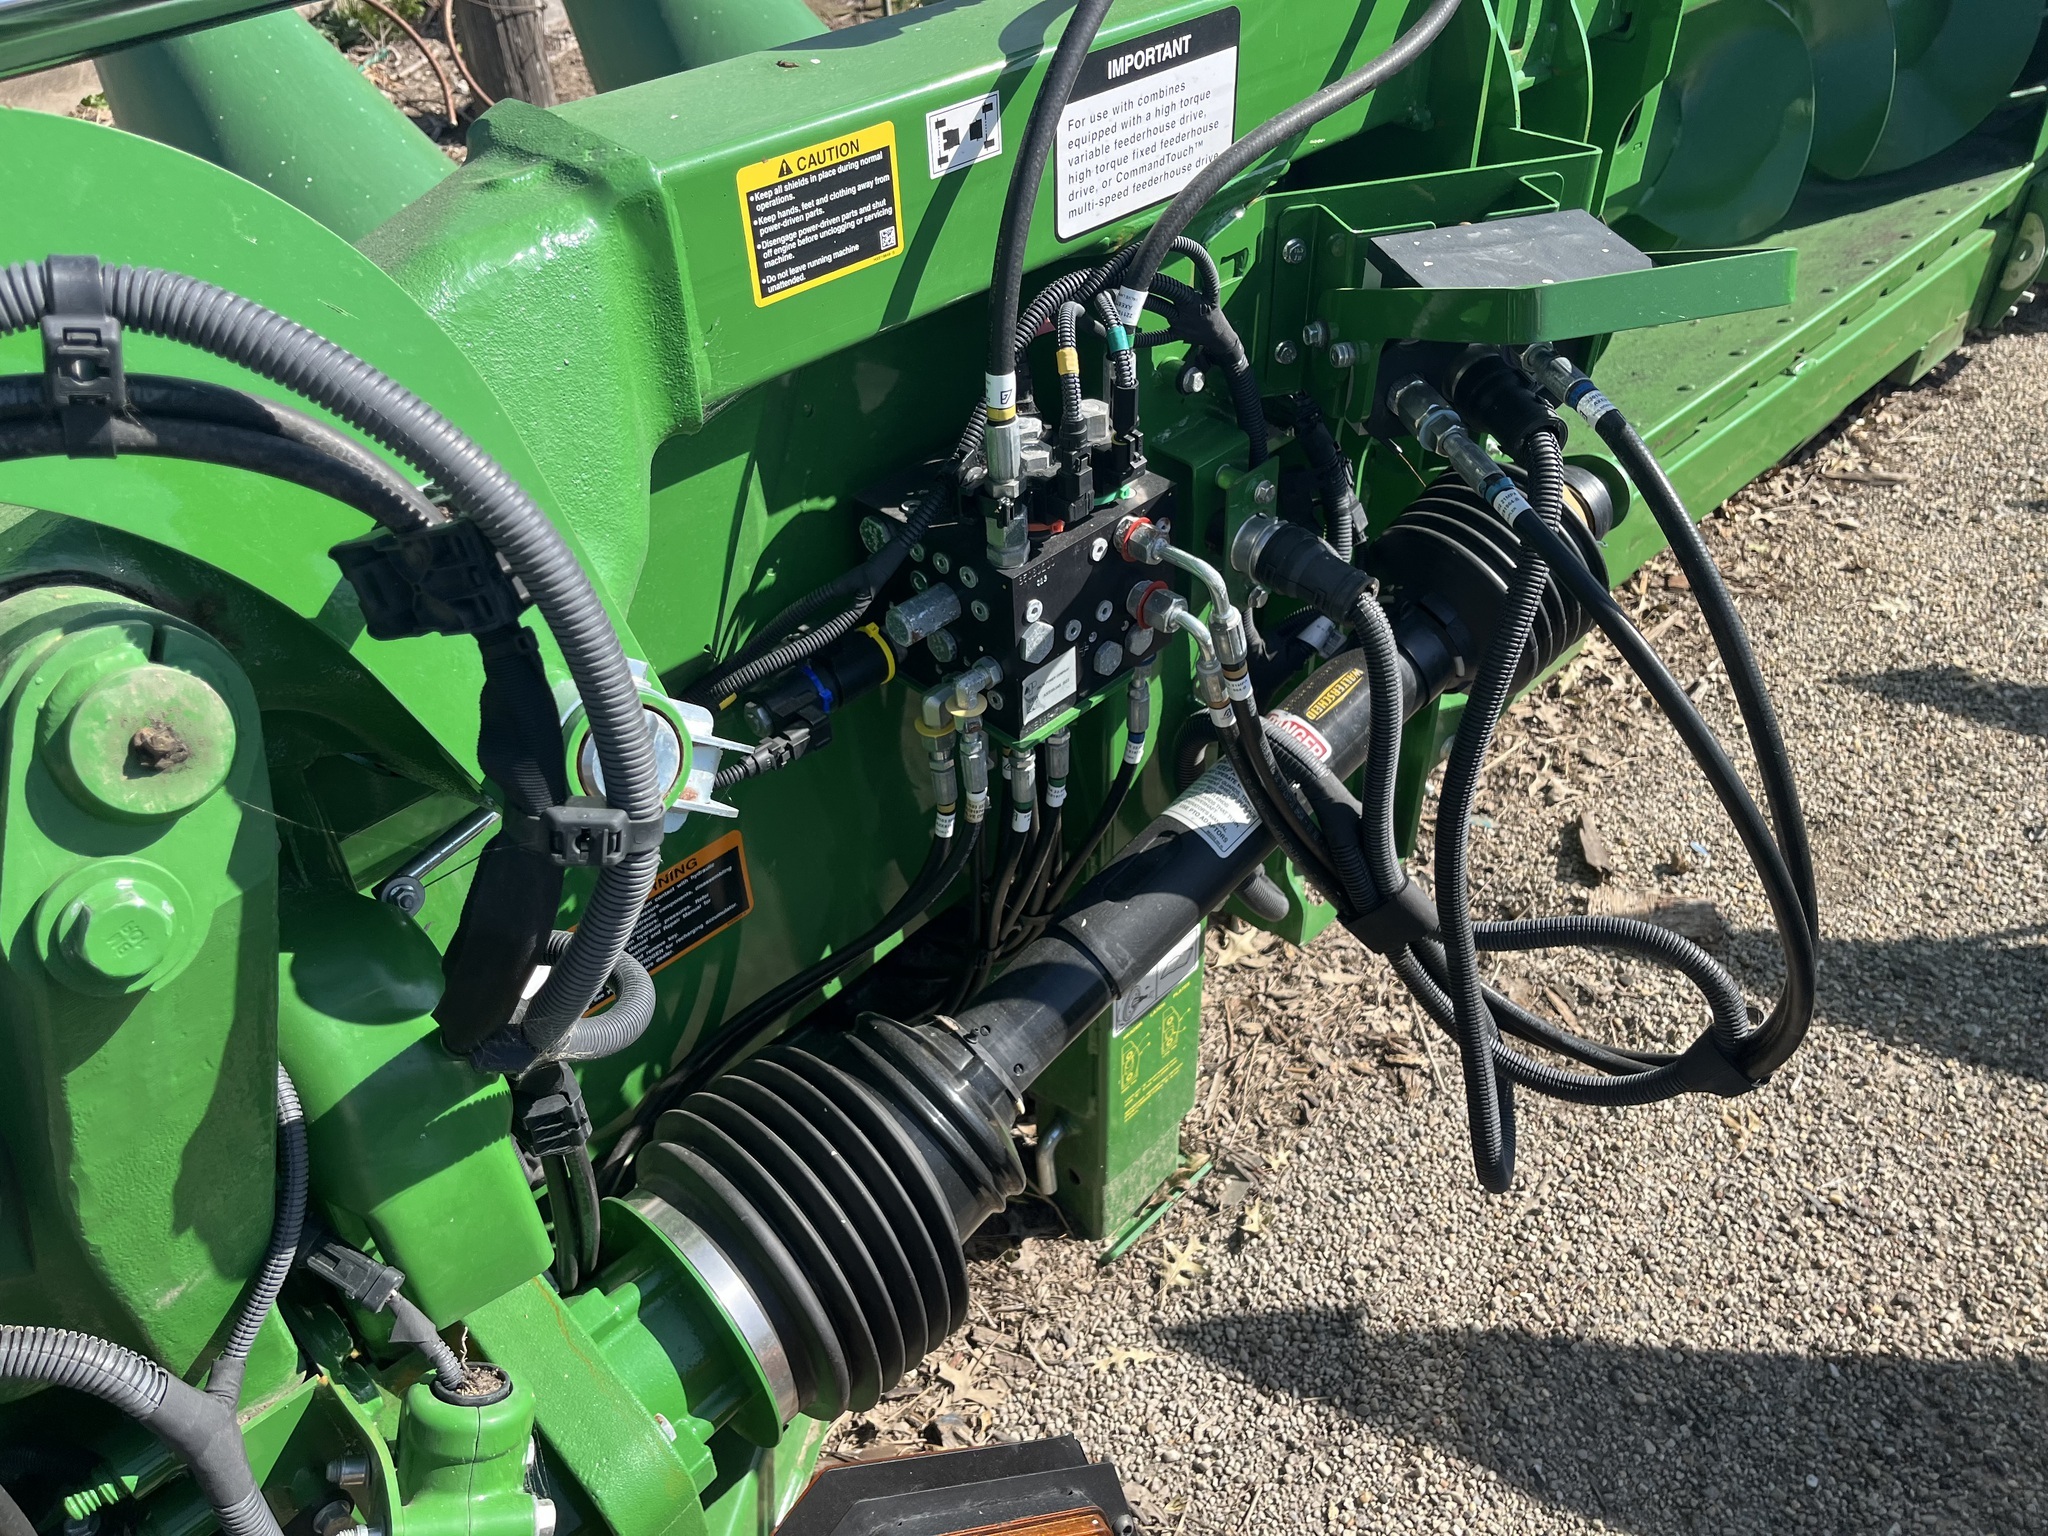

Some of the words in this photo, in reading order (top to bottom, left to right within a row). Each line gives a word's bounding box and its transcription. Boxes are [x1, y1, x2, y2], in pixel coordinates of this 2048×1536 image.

[1108, 34, 1191, 78] IMPORTANT
[1068, 118, 1085, 131] For
[1090, 110, 1108, 123] use
[1112, 99, 1133, 115] with
[1138, 82, 1185, 106] combines
[1068, 122, 1116, 149] equipped
[1121, 114, 1142, 130] with
[1146, 112, 1150, 121] a
[1155, 101, 1176, 117] high
[1180, 90, 1210, 108] torque
[797, 139, 859, 171] CAUTION
[1068, 144, 1110, 166] variable
[1114, 120, 1176, 150] feederhouse
[1179, 110, 1206, 125] drive,
[1068, 168, 1091, 184] high
[1095, 155, 1128, 174] torque
[1132, 142, 1156, 160] fixed
[1160, 120, 1218, 149] feederhouse
[754, 190, 773, 201] Keep
[774, 184, 783, 195] all
[784, 177, 809, 191] shields
[810, 174, 817, 183] in
[818, 168, 836, 182] place
[837, 160, 859, 173] during
[860, 151, 882, 166] normal
[1068, 185, 1098, 202] drive,
[1102, 178, 1112, 188] or
[1068, 186, 1128, 218] multi-speed
[1132, 163, 1192, 193] feederhouse
[756, 193, 795, 212] operations.
[758, 214, 776, 225] Keep
[777, 206, 801, 219] hands,
[801, 199, 815, 210] feet
[815, 194, 828, 206] and
[829, 186, 856, 200] clothing
[857, 180, 874, 191] away
[874, 174, 890, 185] from
[759, 214, 804, 237] power-driven
[805, 208, 825, 221] parts.
[761, 232, 797, 249] Disengage
[798, 216, 840, 238] power-driven
[841, 210, 858, 222] parts
[858, 203, 871, 214] and
[872, 198, 886, 210] shut
[763, 248, 772, 259] off
[773, 240, 796, 255] engine
[797, 234, 818, 246] before
[819, 220, 855, 238] unclogging
[856, 217, 863, 225] or
[864, 206, 892, 222] servicing
[764, 252, 794, 268] machine.
[766, 275, 776, 284] Do
[777, 269, 788, 280] not
[788, 264, 806, 275] leave
[807, 254, 832, 268] running
[832, 244, 859, 259] machine
[768, 273, 806, 293] unattended.
[1305, 668, 1365, 720] WALTERSCHEID
[1189, 807, 1201, 818] PTO
[1200, 816, 1229, 843] ADAPTORS
[1216, 804, 1227, 816] THAT
[652, 858, 698, 891] NING
[676, 879, 688, 888] with
[633, 912, 656, 929] ydraulic
[650, 929, 661, 939] and
